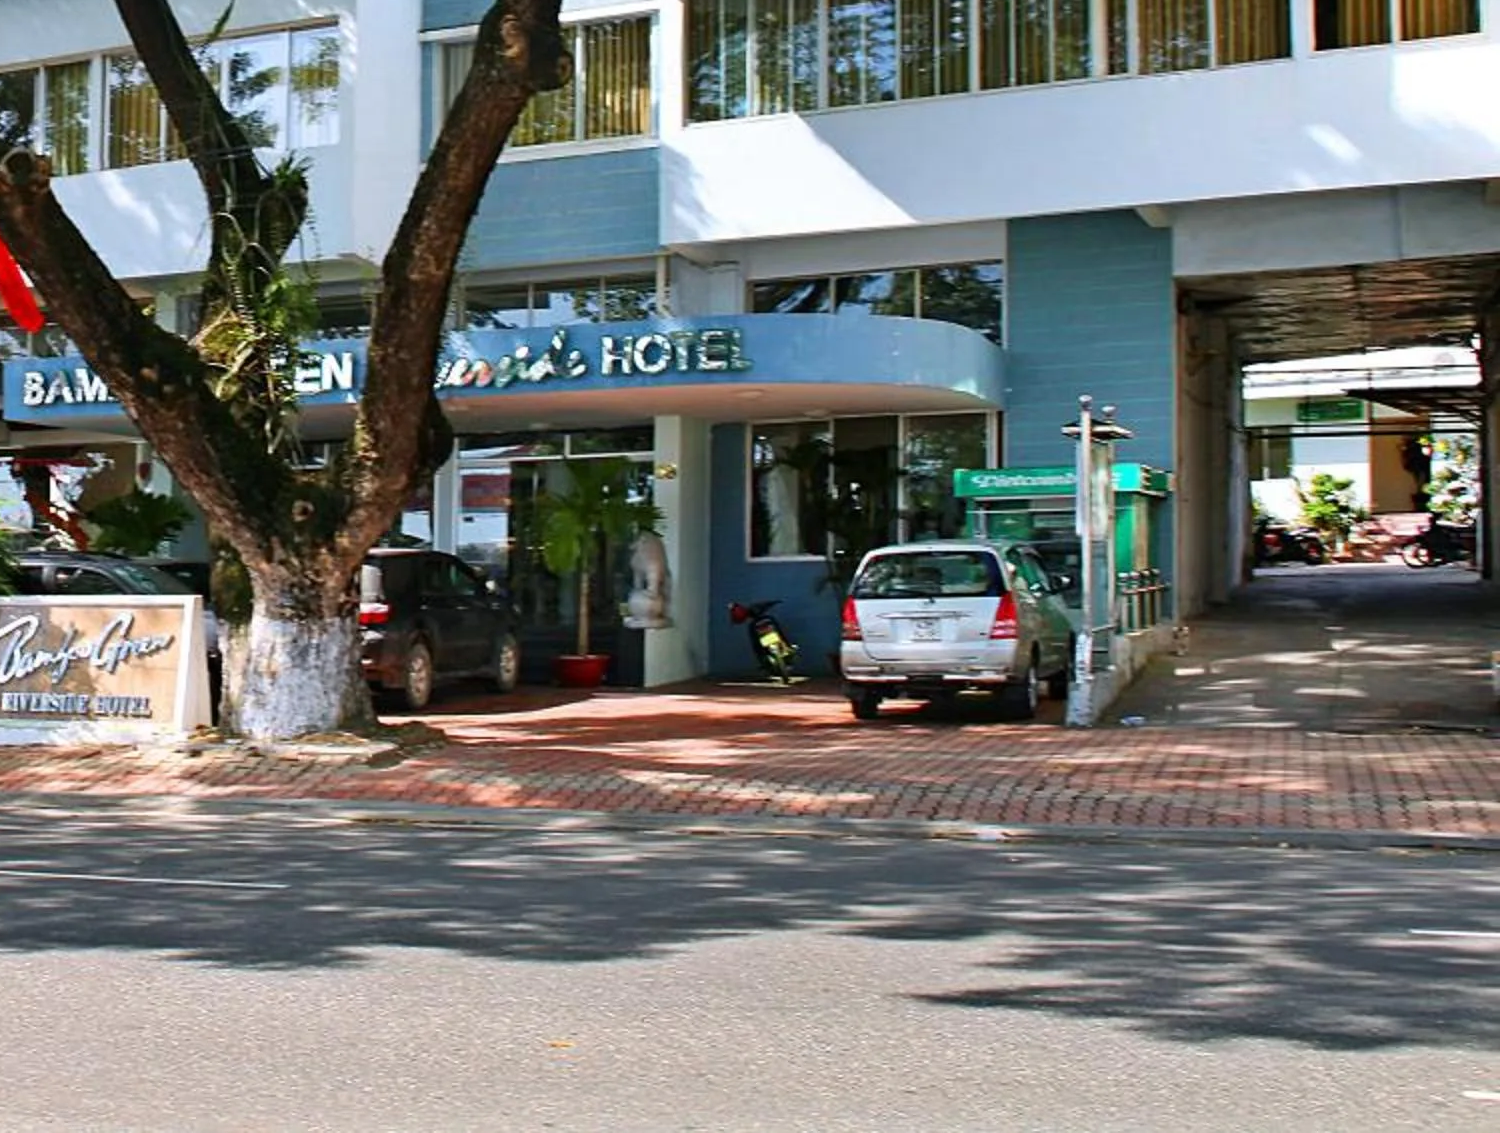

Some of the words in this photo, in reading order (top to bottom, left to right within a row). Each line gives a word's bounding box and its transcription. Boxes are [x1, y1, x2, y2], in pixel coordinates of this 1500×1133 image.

[600, 328, 750, 376] HOTEL
[1, 692, 90, 715] RIVERSIDE
[94, 696, 152, 718] HOTEL
